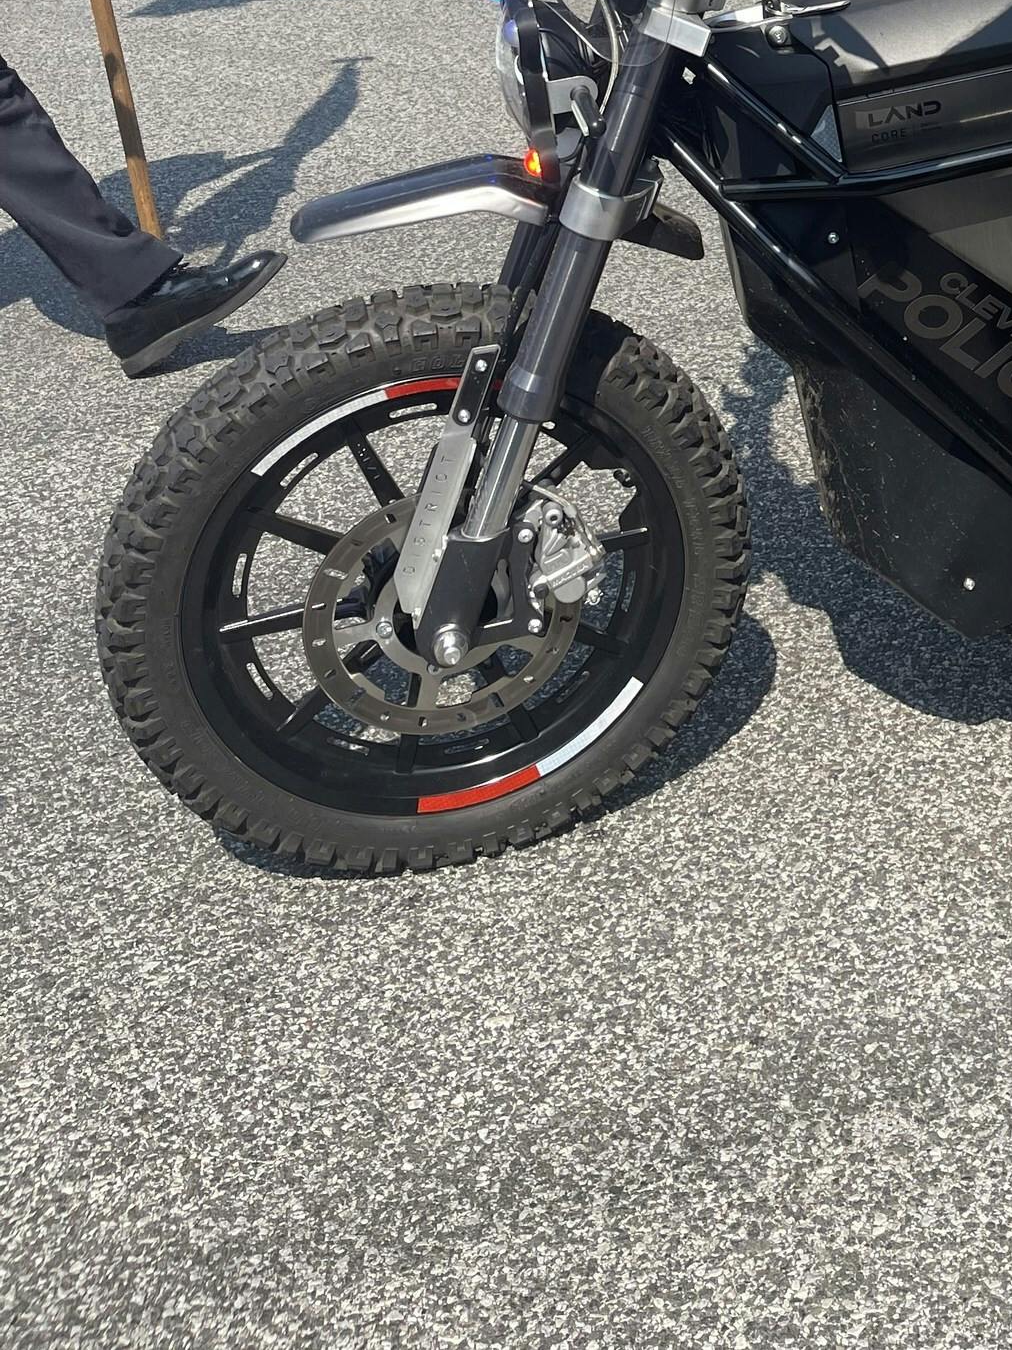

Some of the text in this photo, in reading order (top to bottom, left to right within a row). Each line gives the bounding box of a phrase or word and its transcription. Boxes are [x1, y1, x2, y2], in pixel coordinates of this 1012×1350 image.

[867, 99, 942, 128] LAND
[871, 128, 908, 144] CORE
[402, 454, 456, 575] DISTRICT
